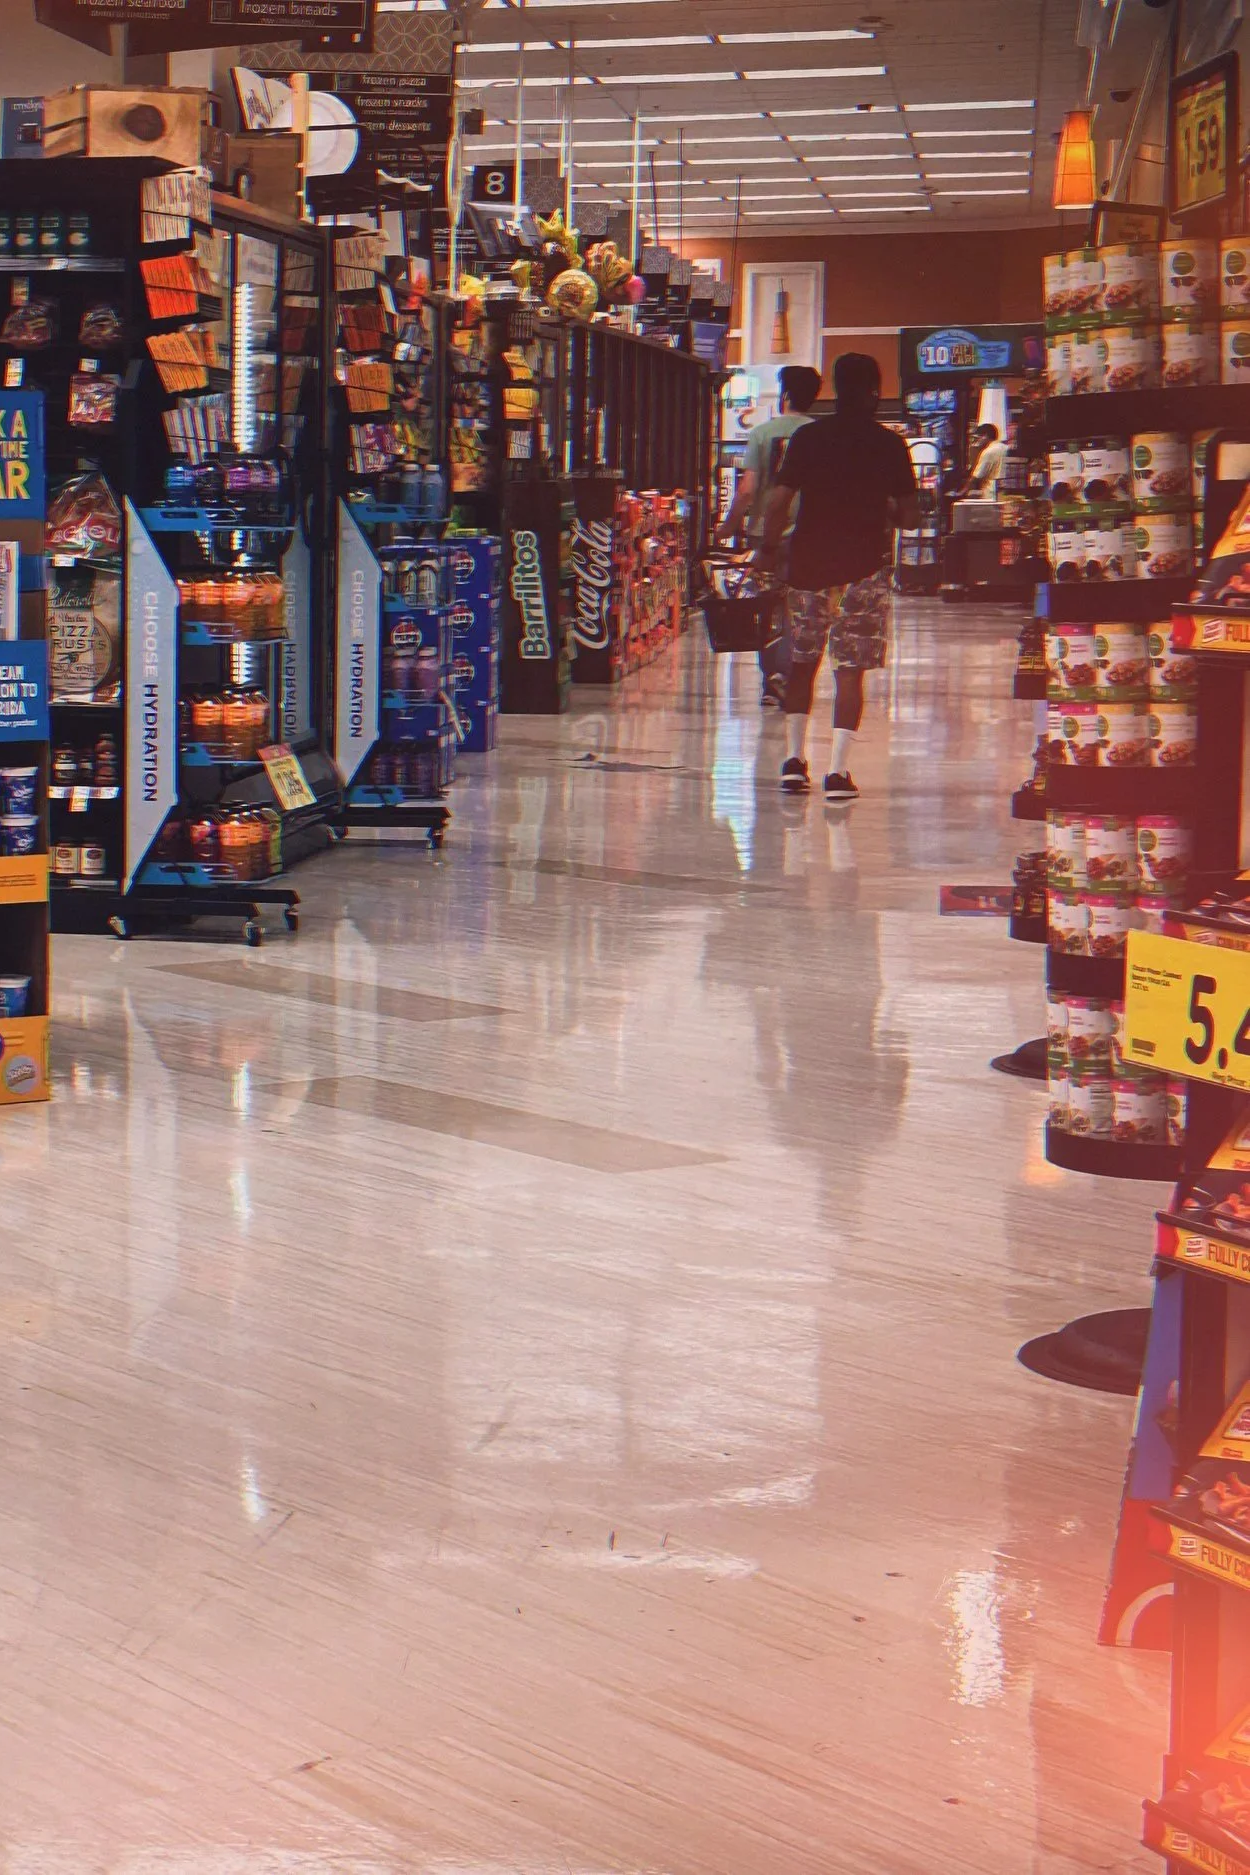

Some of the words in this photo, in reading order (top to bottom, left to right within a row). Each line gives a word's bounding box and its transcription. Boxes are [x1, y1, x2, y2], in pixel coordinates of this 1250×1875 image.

[239, 2, 285, 14] frozen
[289, 2, 338, 16] breads
[362, 74, 395, 85] frozen
[485, 171, 505, 195] 8
[11, 409, 28, 438] A
[569, 518, 612, 649] Coca-Cola
[352, 570, 365, 640] CHOOSE
[49, 625, 100, 637] PIZZA
[143, 591, 159, 678] CHOOSE
[19, 683, 38, 697] TO
[349, 643, 364, 738] HYDRATION
[141, 684, 159, 802] HYDRATION
[1208, 1242, 1240, 1270] FULLY
